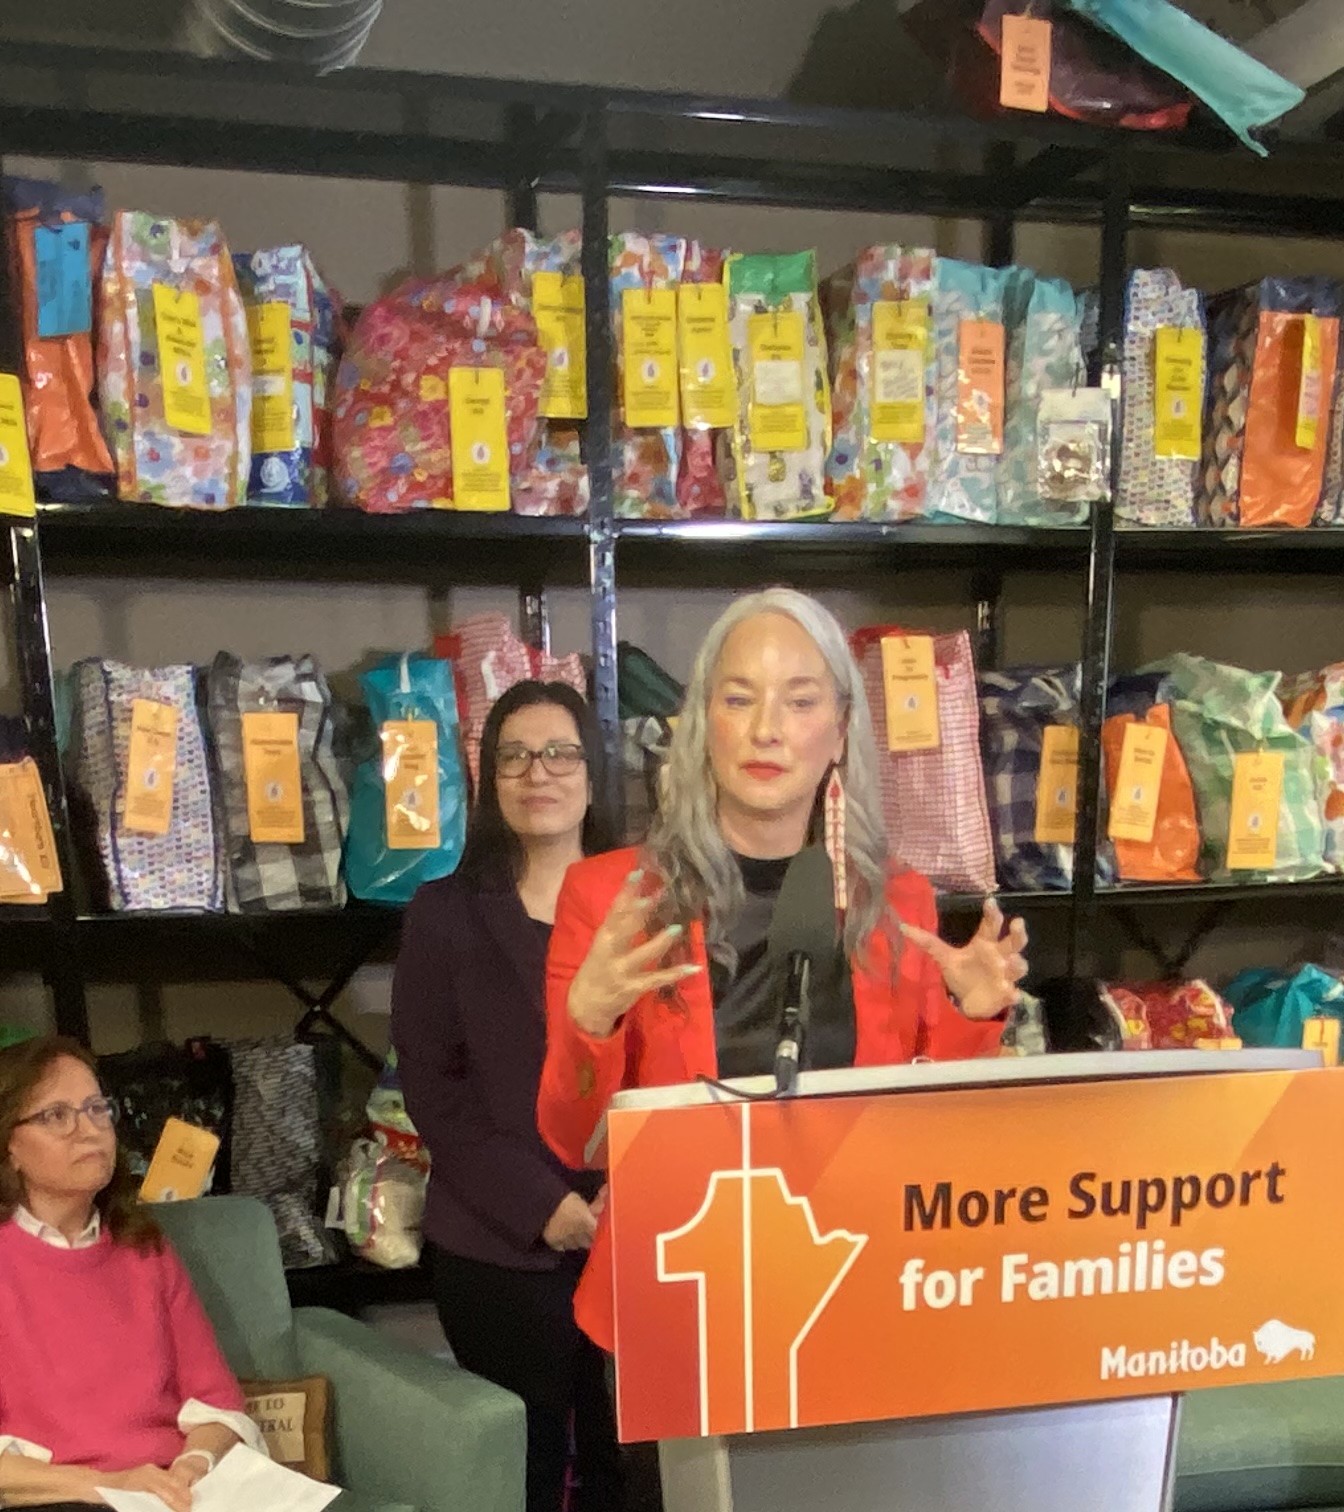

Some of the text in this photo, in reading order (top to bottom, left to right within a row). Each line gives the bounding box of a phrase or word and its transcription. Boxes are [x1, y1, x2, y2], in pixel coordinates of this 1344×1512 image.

[903, 1160, 1287, 1233] More Support
[899, 1238, 1225, 1311] for Families
[1099, 1337, 1247, 1381] Manitoba
